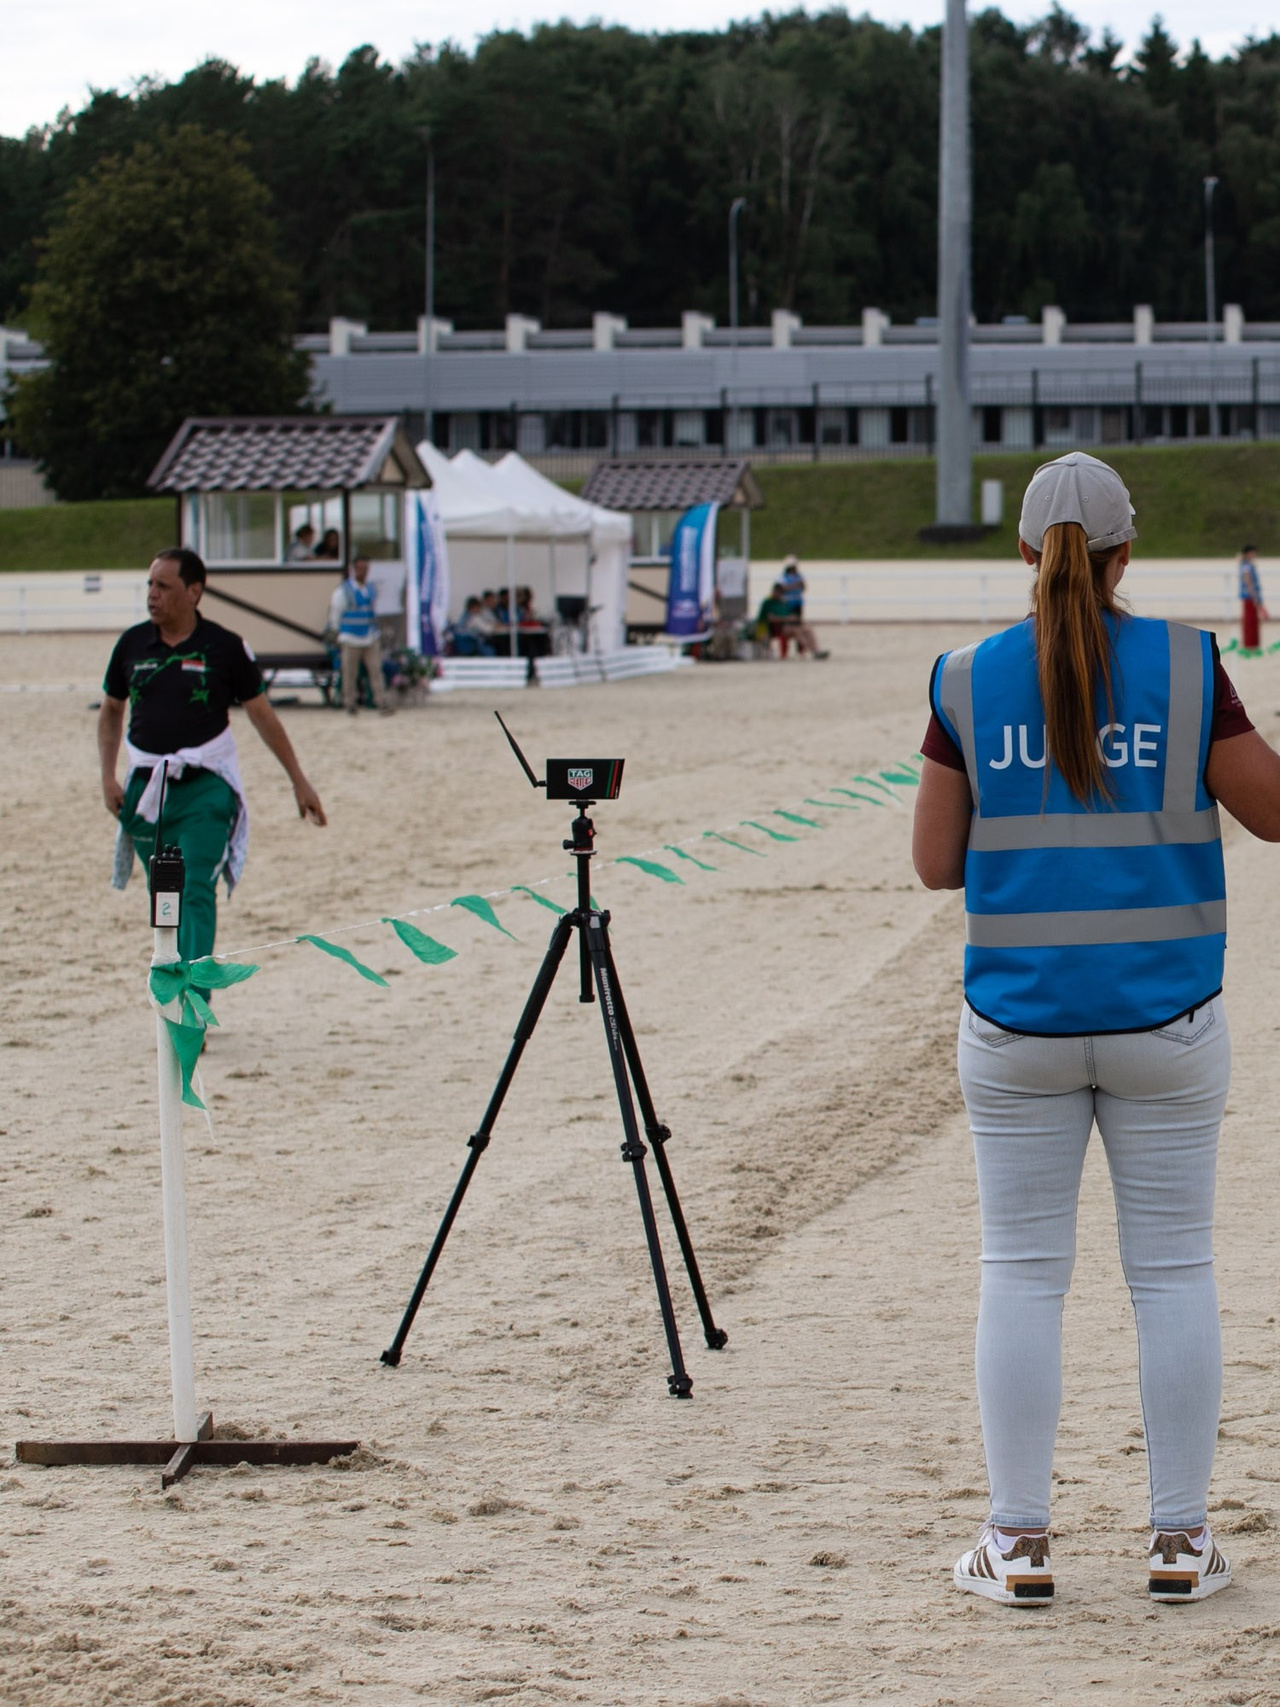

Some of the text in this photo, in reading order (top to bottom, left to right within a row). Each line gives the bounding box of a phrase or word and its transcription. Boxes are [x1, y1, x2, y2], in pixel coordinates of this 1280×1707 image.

[988, 722, 1162, 770] JUGE
[162, 902, 171, 916] 2
[600, 967, 614, 1016] Manfrotto
